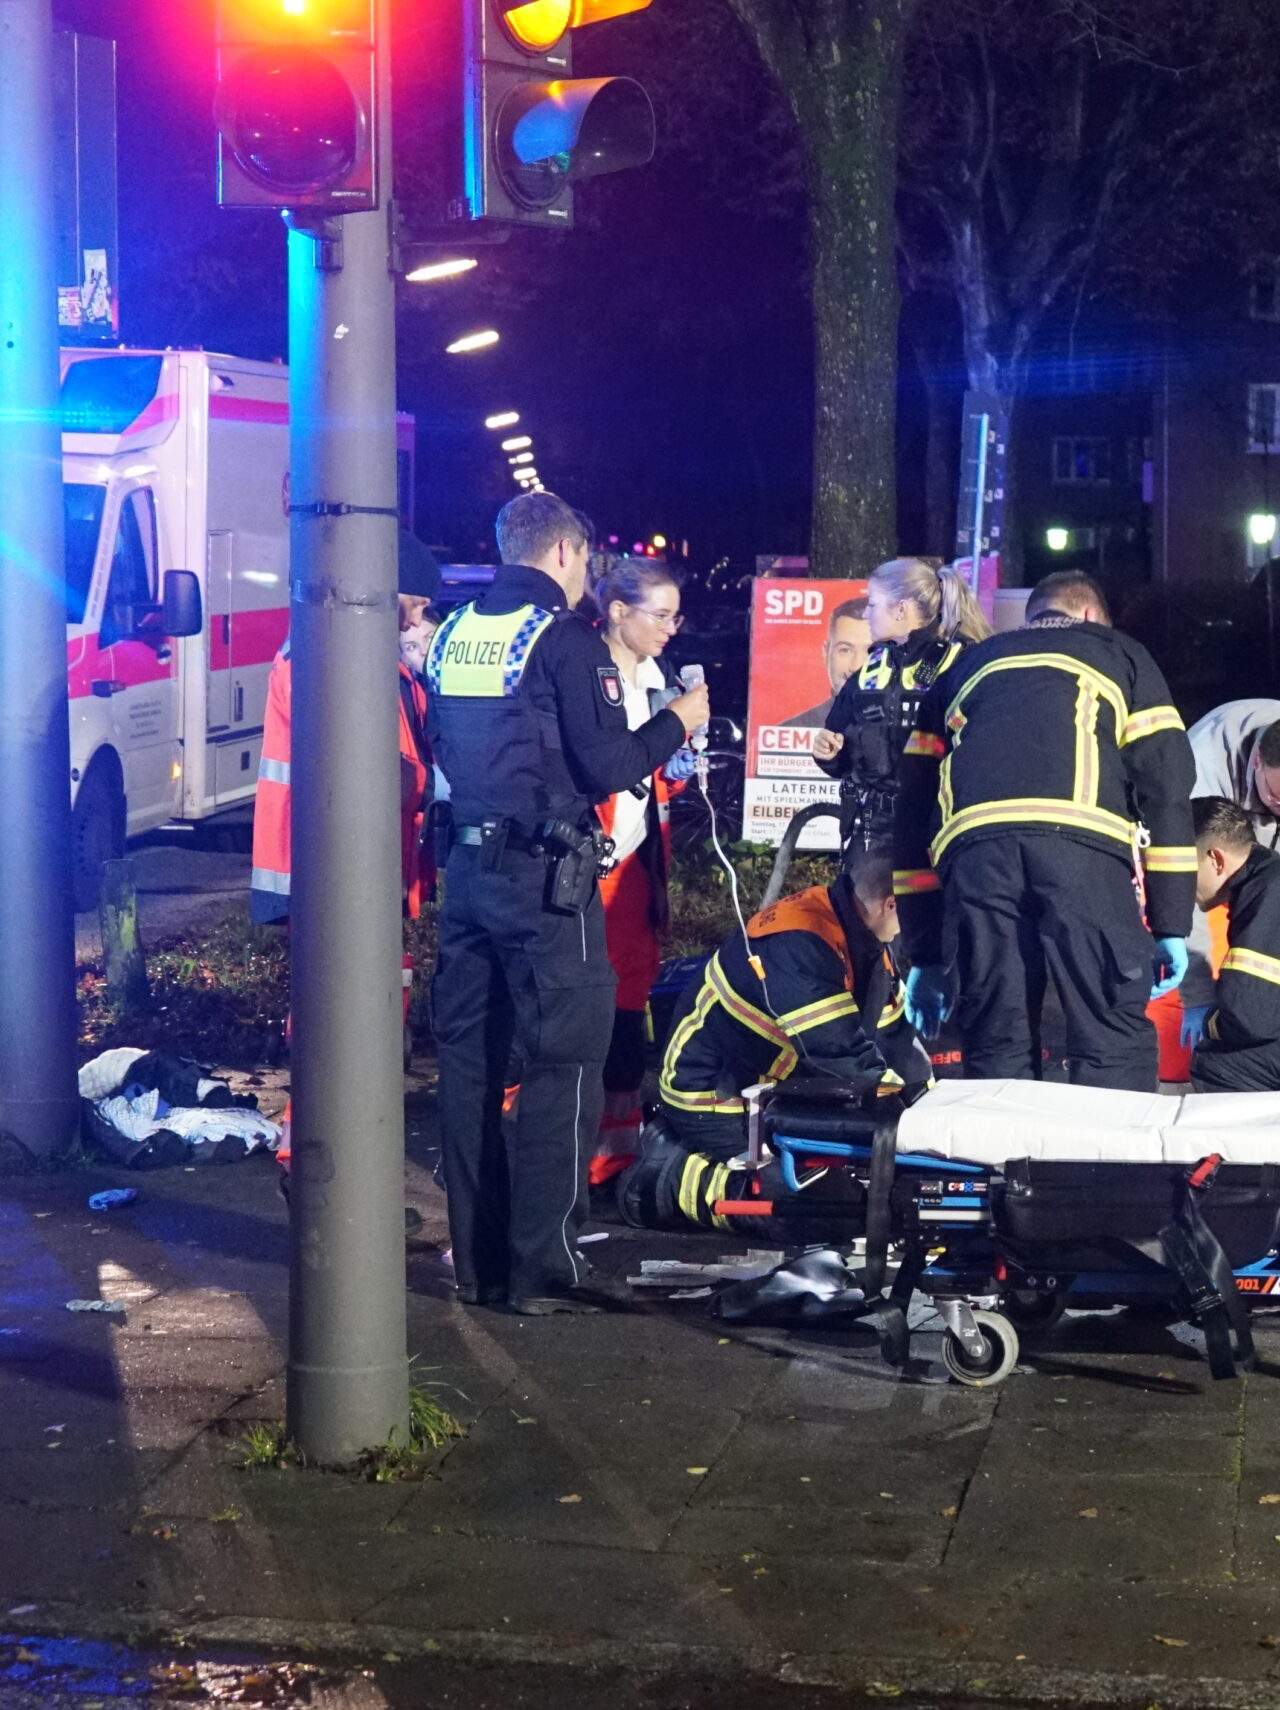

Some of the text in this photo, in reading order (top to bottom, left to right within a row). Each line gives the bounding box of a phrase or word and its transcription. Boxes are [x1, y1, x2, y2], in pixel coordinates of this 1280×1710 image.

[765, 589, 823, 616] SPD
[445, 640, 506, 666] POLIZEI
[762, 729, 811, 750] CEM
